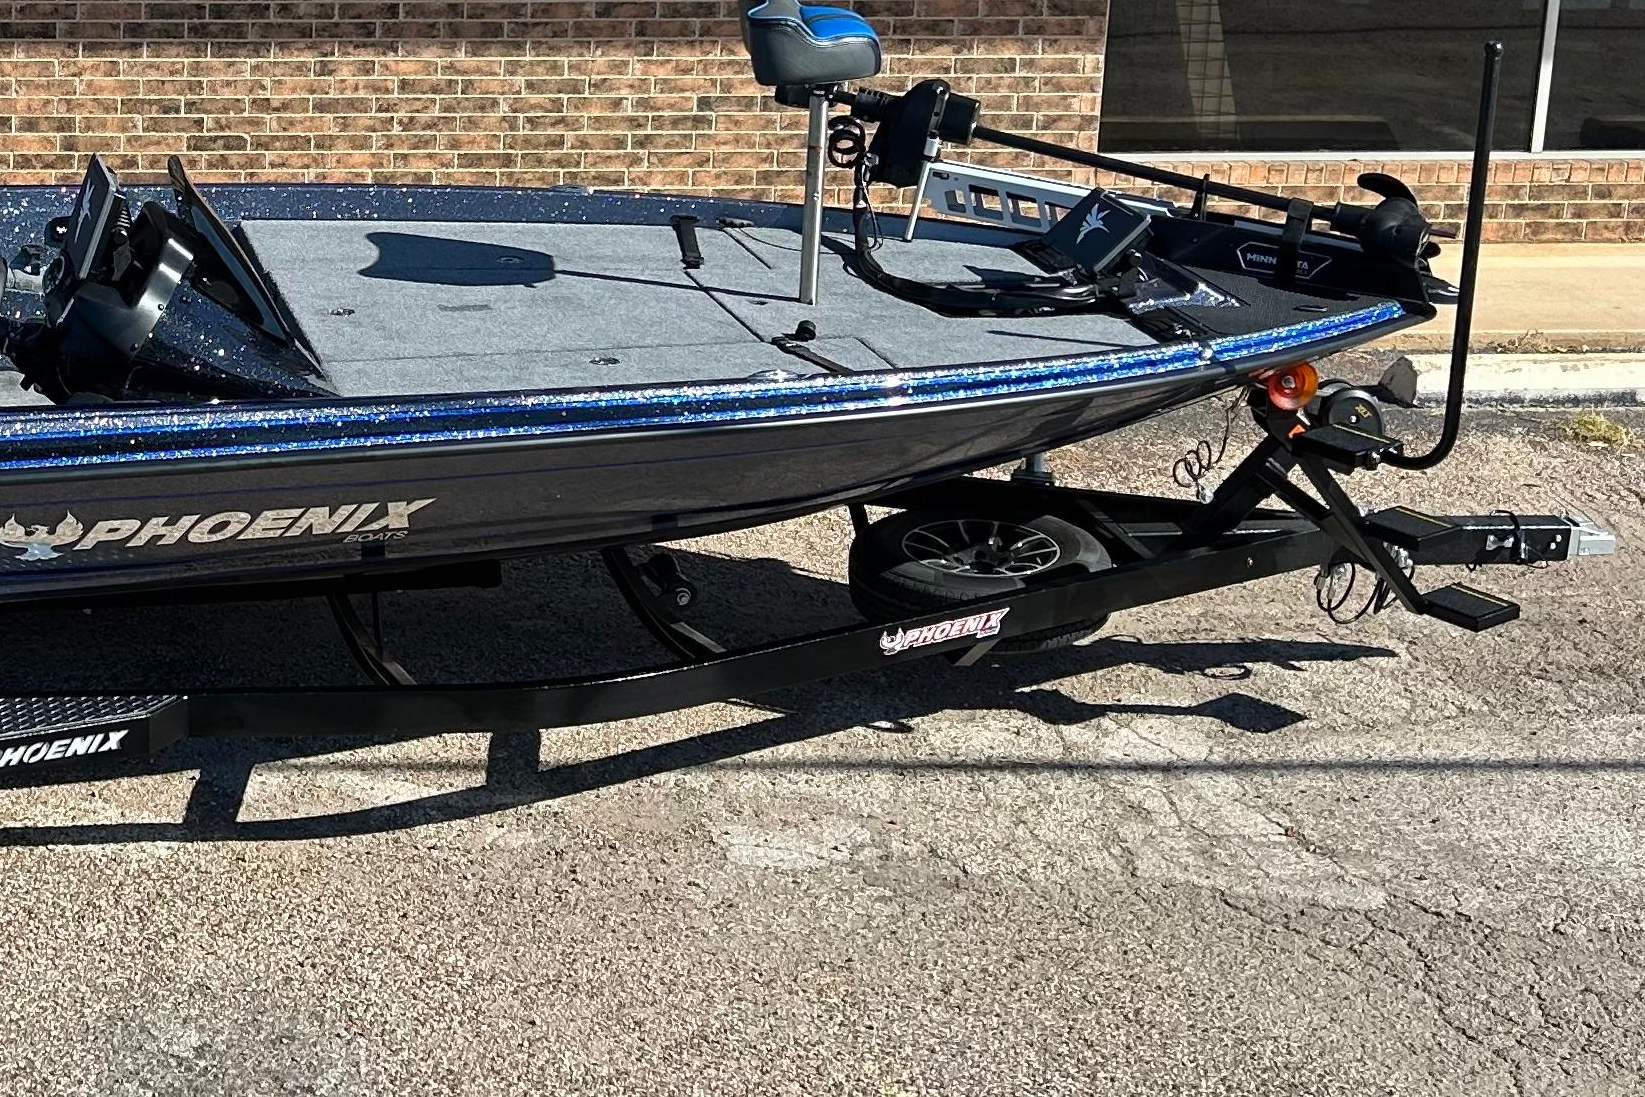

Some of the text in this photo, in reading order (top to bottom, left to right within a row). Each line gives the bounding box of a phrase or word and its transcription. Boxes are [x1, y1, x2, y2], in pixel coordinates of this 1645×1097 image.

[72, 498, 437, 551] PHOENIX
[342, 530, 409, 543] BOATS
[903, 608, 1008, 646] PHOENIX
